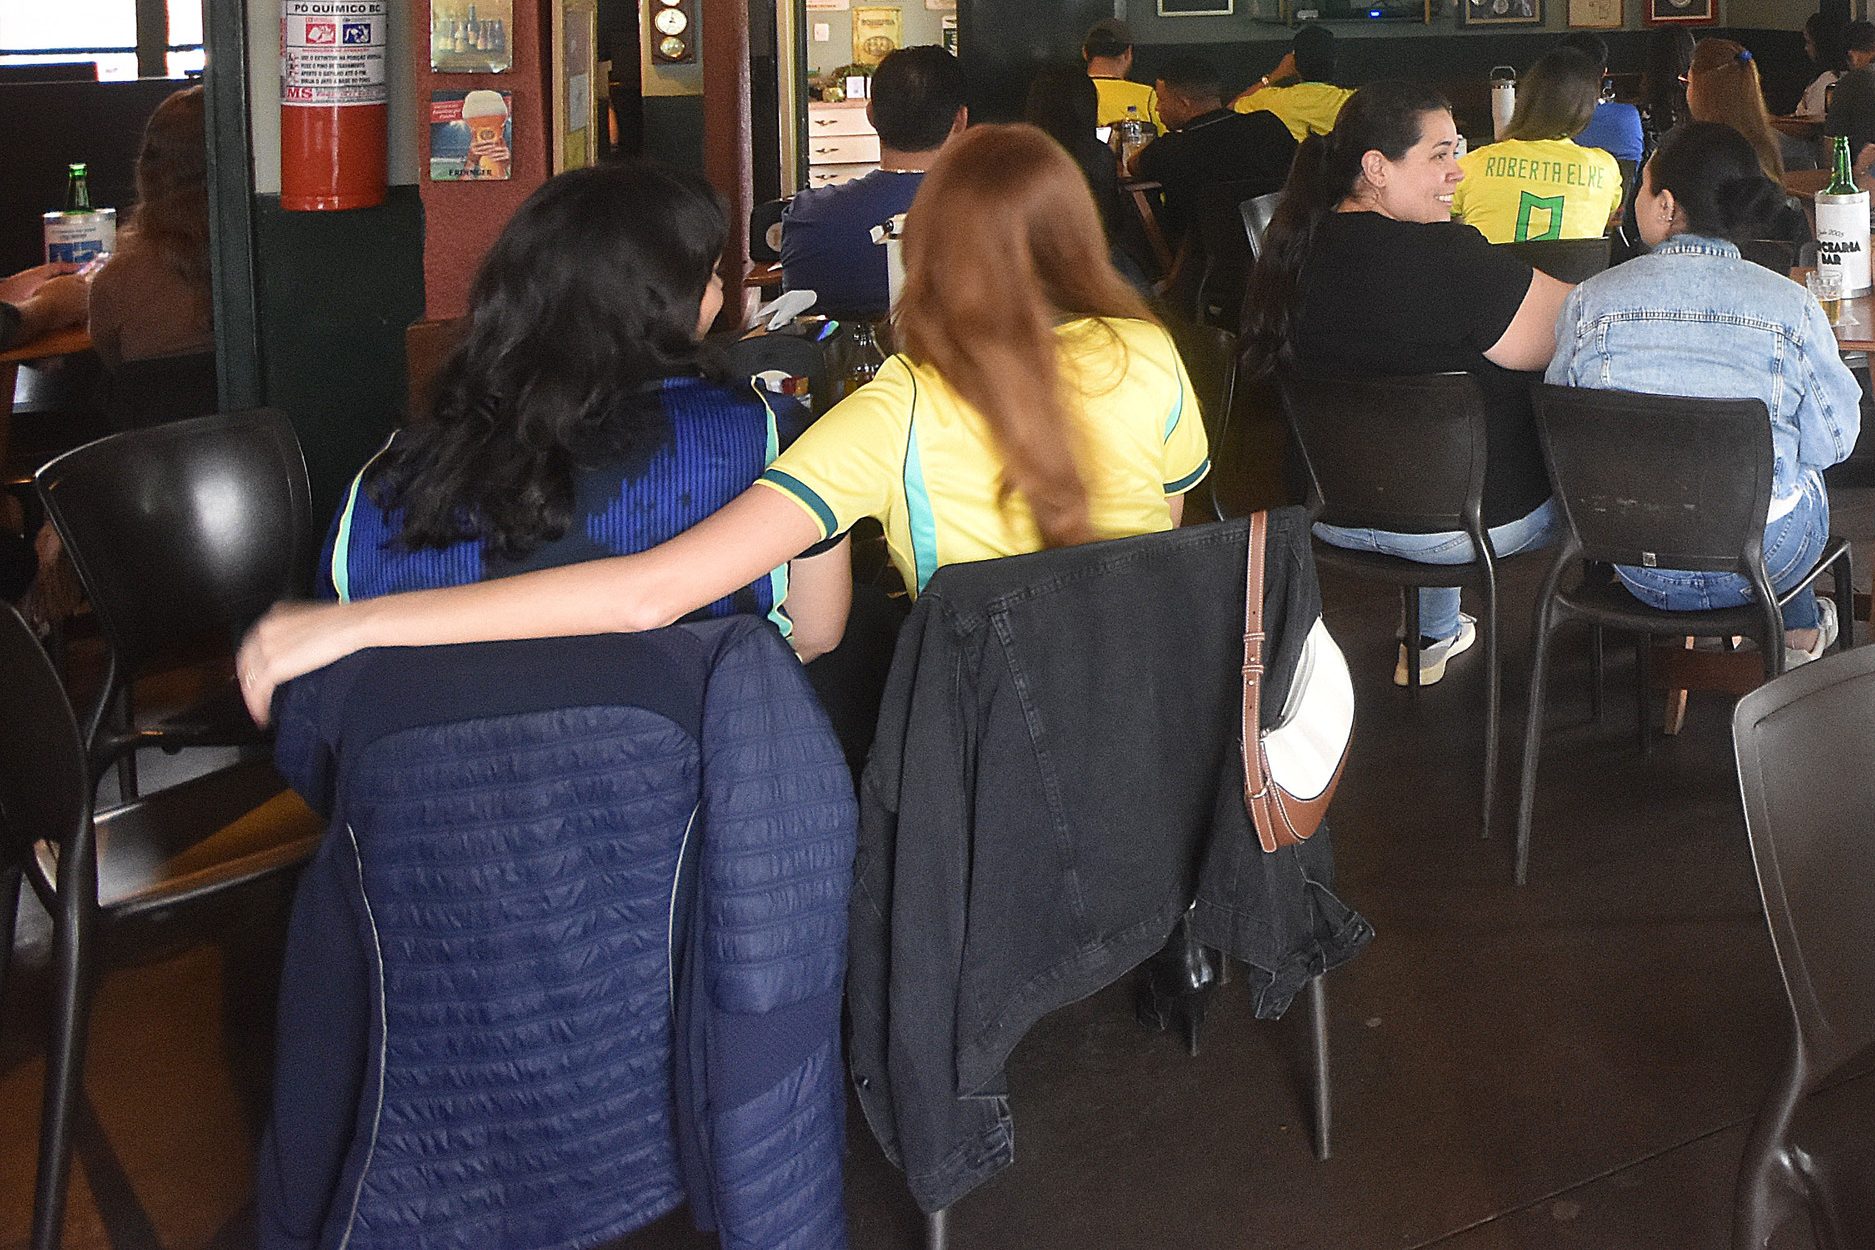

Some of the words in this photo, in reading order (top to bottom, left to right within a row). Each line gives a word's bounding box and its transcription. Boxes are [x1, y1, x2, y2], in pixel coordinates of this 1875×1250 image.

[287, 88, 313, 98] MS
[449, 168, 493, 176] ERDINGER
[1485, 156, 1562, 183] ROBERTA
[1567, 163, 1605, 189] ELKE
